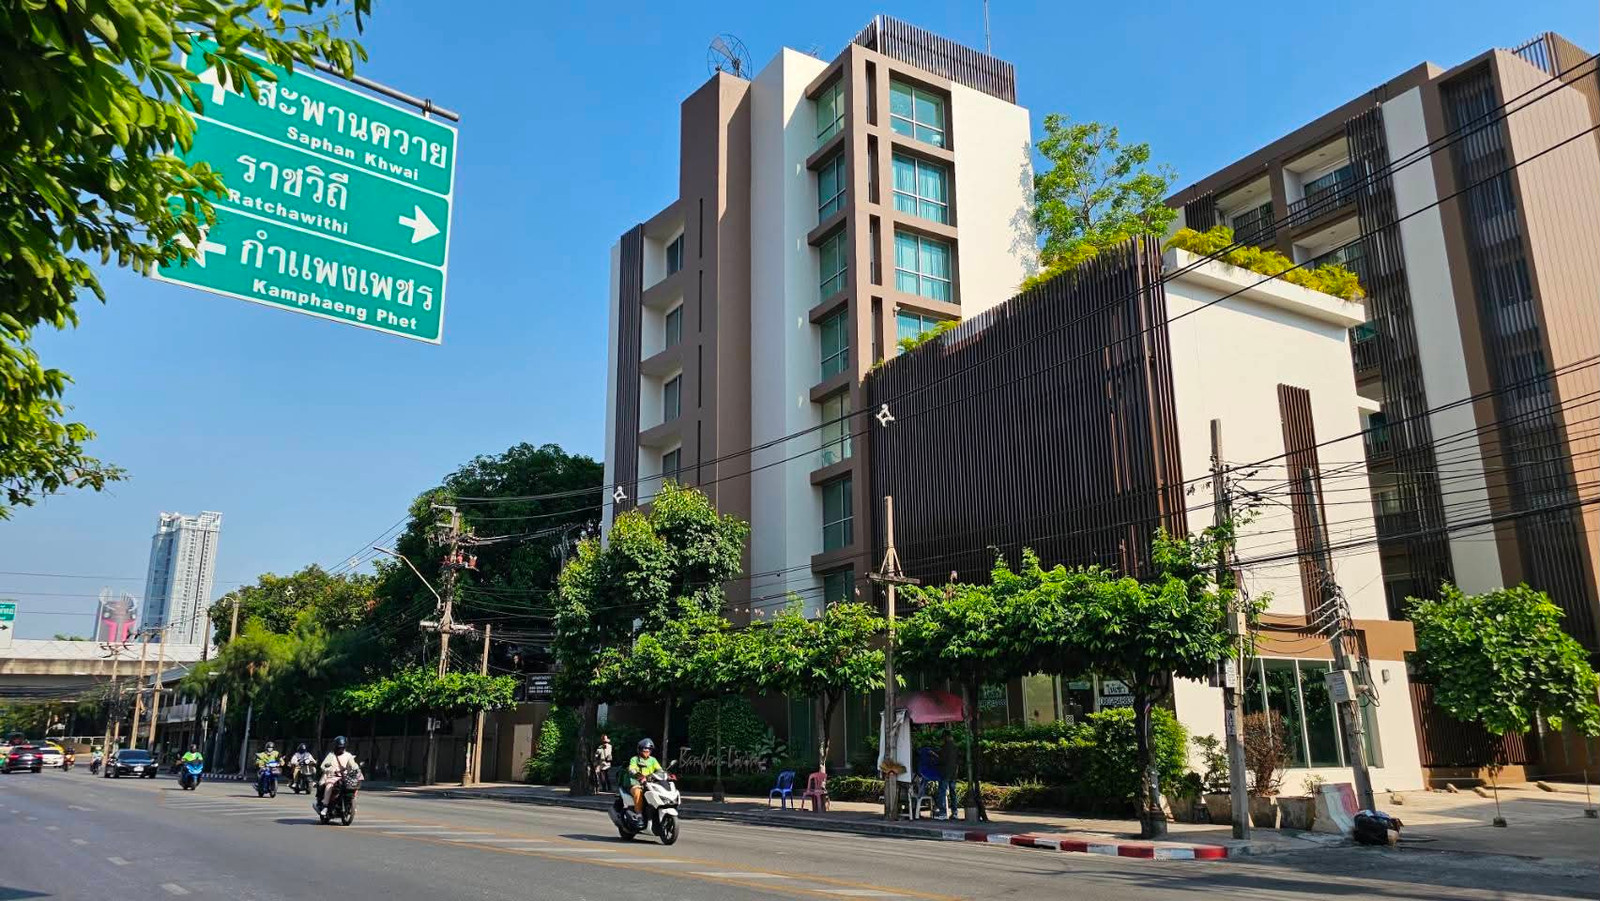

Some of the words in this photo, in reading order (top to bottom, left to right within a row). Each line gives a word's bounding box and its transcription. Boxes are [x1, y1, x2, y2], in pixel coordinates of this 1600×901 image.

[256, 80, 447, 169] สะพานควาย
[287, 126, 355, 160] Saphan
[364, 151, 419, 181] Khwai
[237, 154, 349, 211] ราชวิถี
[227, 188, 348, 235] Ratchawithi
[240, 229, 434, 311] กำแพงเพชร
[252, 278, 367, 321] Kamphaeng
[376, 308, 418, 330] Phet
